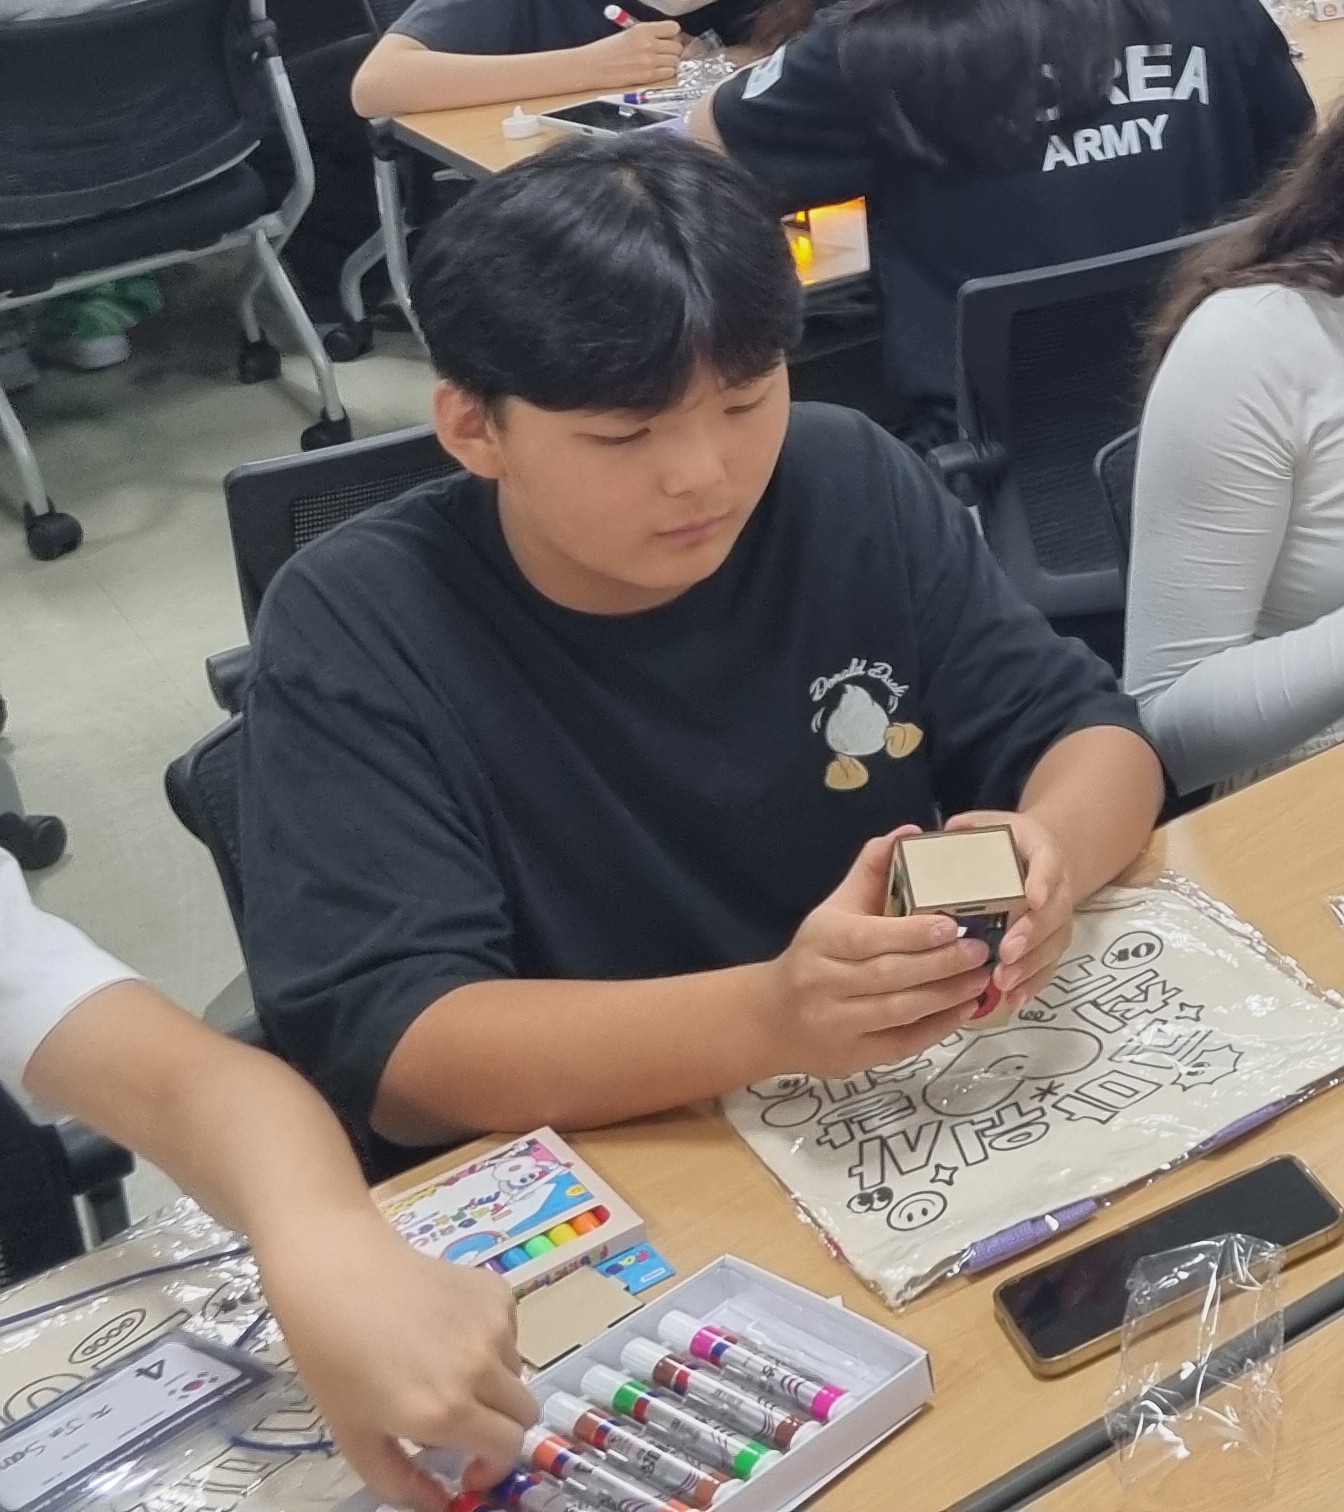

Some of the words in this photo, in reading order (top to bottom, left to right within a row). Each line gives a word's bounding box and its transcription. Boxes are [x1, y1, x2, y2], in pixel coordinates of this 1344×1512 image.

[1042, 113, 1169, 172] ARMY
[1108, 939, 1158, 965] OK
[82, 1317, 135, 1356] GOOD
[134, 1359, 165, 1381] 4
